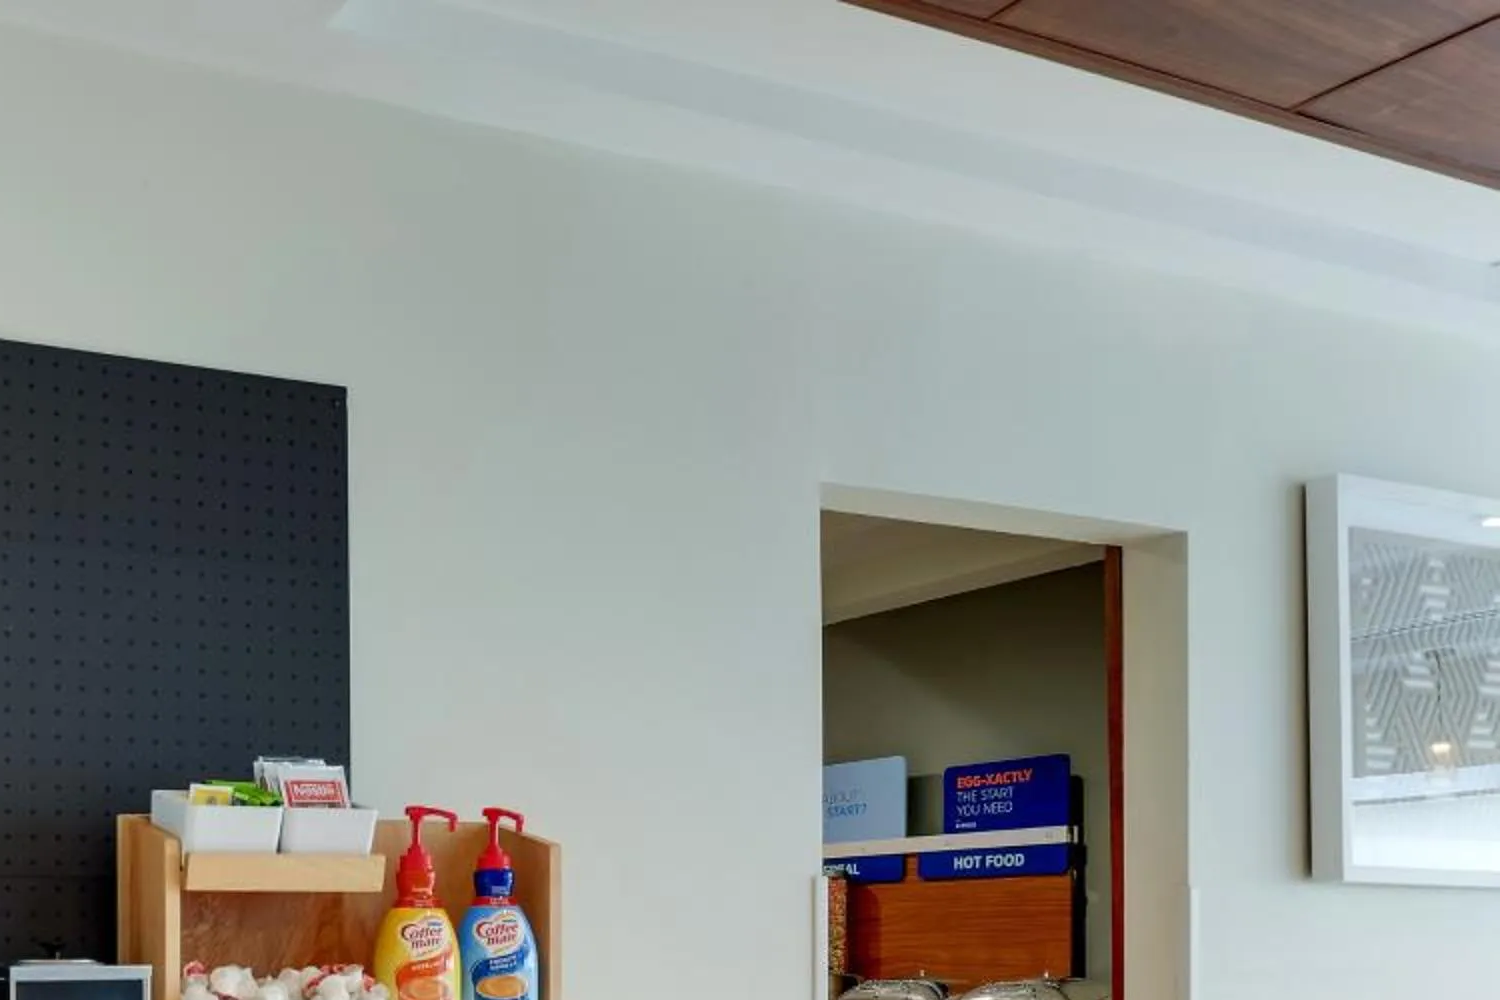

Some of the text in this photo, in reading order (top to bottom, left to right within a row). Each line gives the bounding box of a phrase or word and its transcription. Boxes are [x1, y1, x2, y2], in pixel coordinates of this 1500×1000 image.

[957, 768, 1032, 789] EGG-XACTLY
[956, 786, 1015, 803] THE START
[956, 801, 1013, 817] YOU NEED
[953, 853, 1025, 870] HOT FOOD
